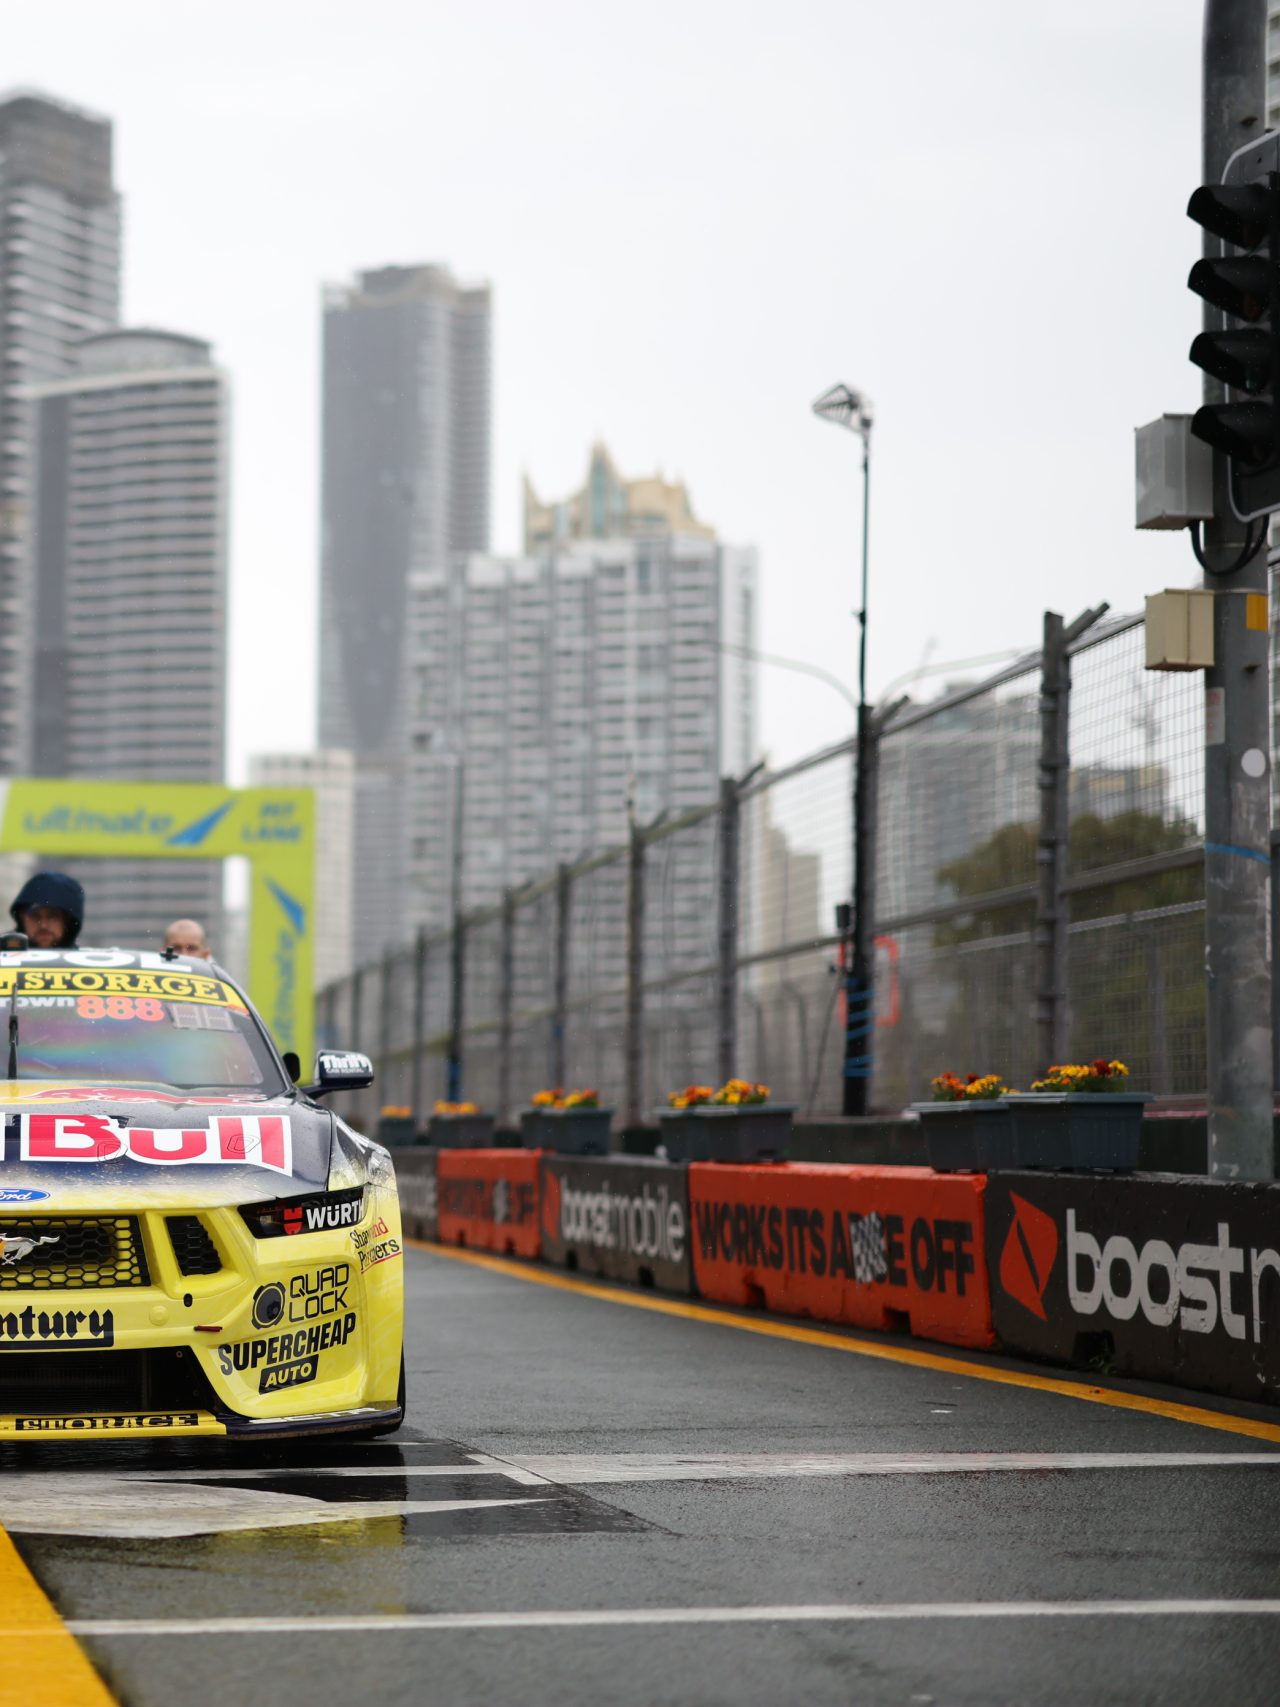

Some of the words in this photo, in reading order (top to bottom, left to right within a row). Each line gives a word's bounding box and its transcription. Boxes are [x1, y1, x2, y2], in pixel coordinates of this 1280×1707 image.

[23, 972, 219, 999] STORAGE
[76, 994, 165, 1022] 888
[23, 1112, 291, 1175] Bull
[695, 1201, 784, 1272] WORKS
[786, 1207, 826, 1278] ITS
[910, 1216, 975, 1297] OFF
[290, 1264, 349, 1298] QUAD
[289, 1287, 348, 1322] LOCK
[218, 1312, 356, 1375] SUPERCHEAP
[264, 1362, 312, 1388] AUTO
[22, 1414, 192, 1430] STORAGE
